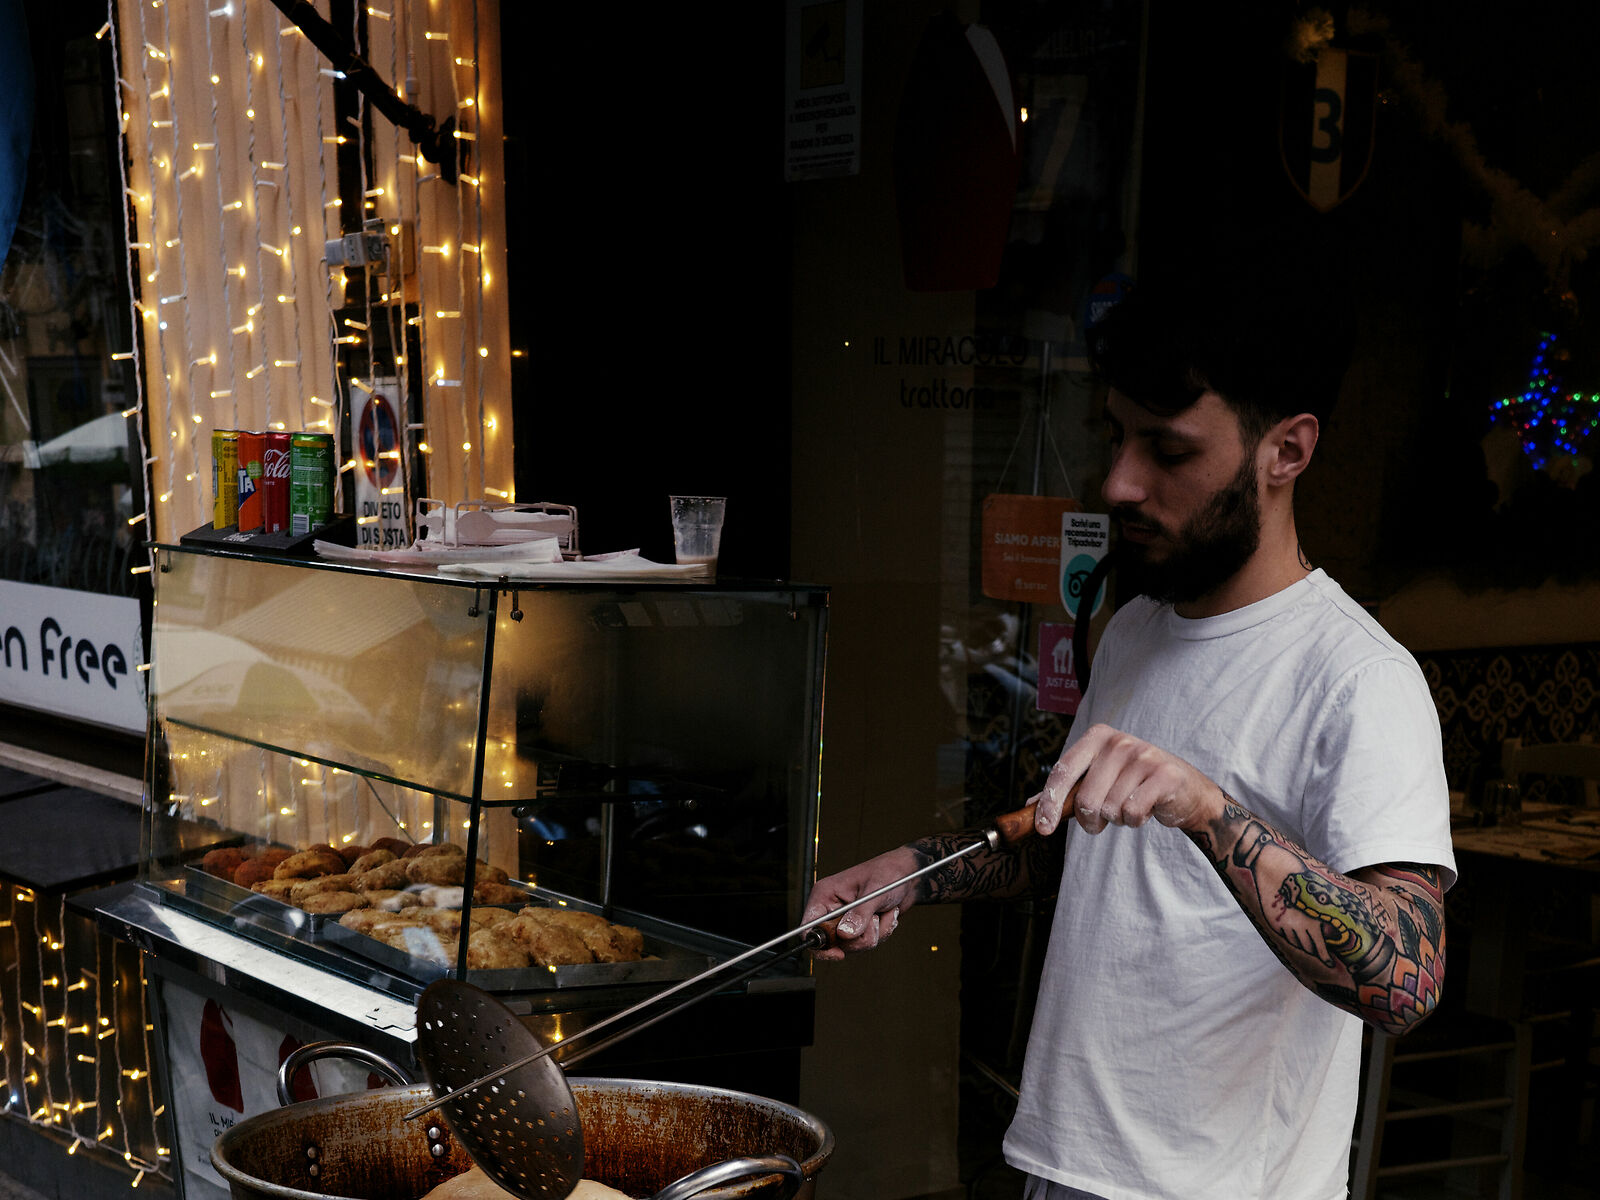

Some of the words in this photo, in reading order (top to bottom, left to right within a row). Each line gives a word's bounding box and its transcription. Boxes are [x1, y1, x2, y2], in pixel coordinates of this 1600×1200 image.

[1309, 88, 1341, 163] 3
[873, 336, 892, 365] IL
[363, 501, 401, 519] DIVETO
[361, 527, 372, 543] DI
[994, 532, 1029, 547] SIAMO
[0, 626, 28, 671] n
